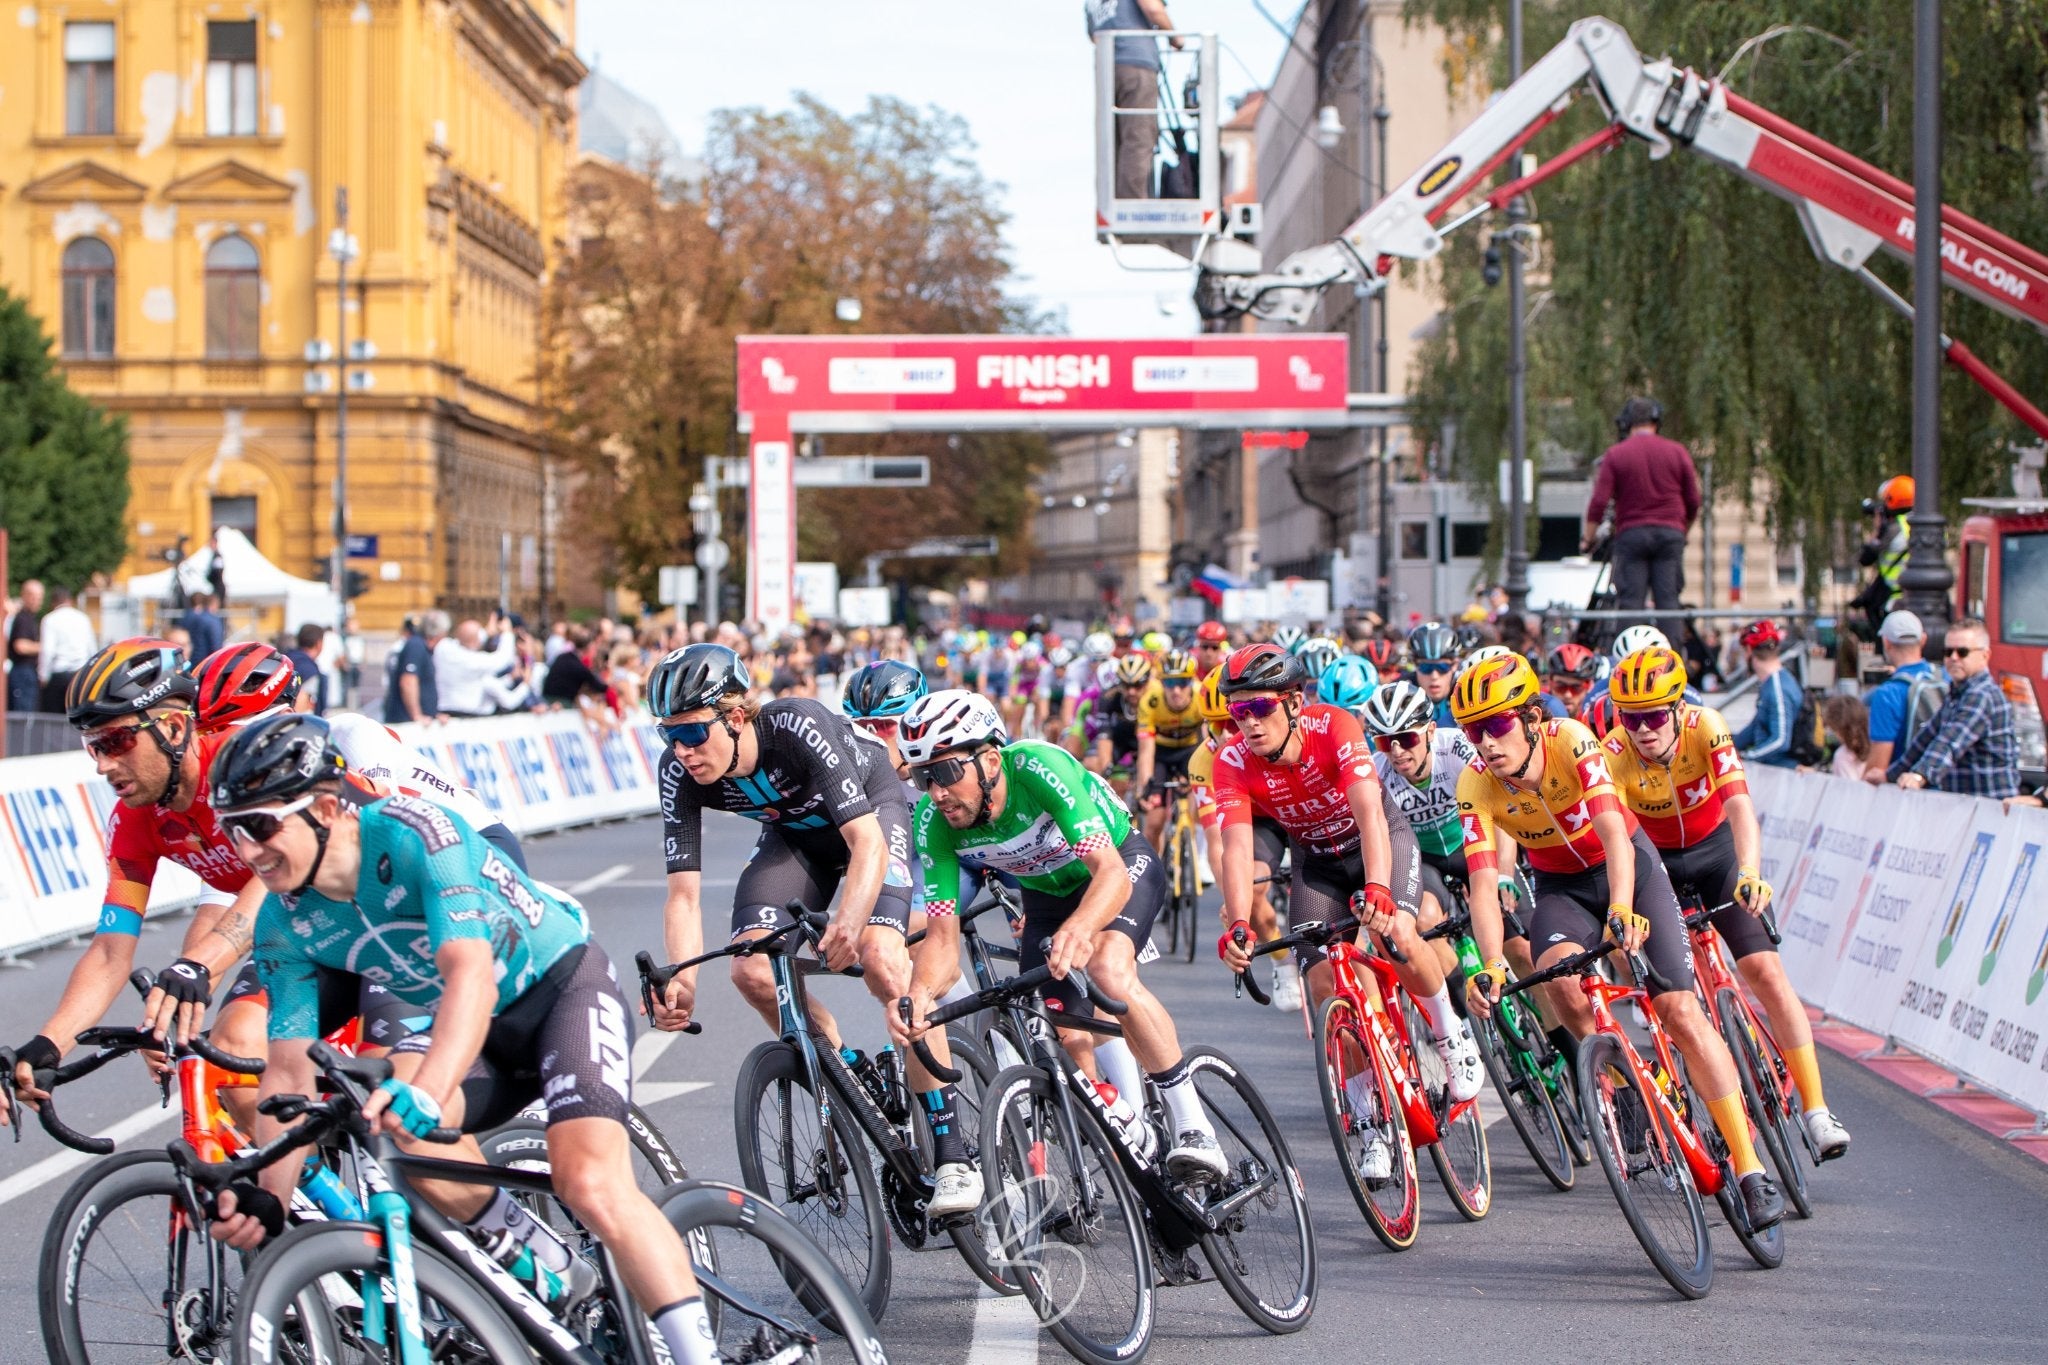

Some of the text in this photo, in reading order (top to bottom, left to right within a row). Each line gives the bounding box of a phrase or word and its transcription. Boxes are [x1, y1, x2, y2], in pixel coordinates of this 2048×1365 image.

[1896, 217, 2029, 300] RAL.COM
[977, 355, 1110, 388] FINISH
[132, 677, 172, 708] RUDY
[260, 663, 290, 696] TREK
[701, 675, 728, 700] SCOTT
[1265, 676, 1290, 688] RUDY
[769, 712, 840, 769] youfone
[411, 767, 455, 798] TREK
[661, 760, 685, 824] youfo
[1026, 757, 1076, 810] ŠKODA
[1275, 786, 1345, 819] HRE
[1401, 787, 1453, 812] CAJA
[1405, 802, 1457, 824] URA
[1456, 801, 1474, 811] no
[1638, 801, 1673, 812] Uno
[918, 799, 939, 848] ŠKOD
[1517, 827, 1556, 841] Uno
[171, 845, 239, 870] BAHR
[890, 825, 908, 860] DSM
[495, 1137, 548, 1154] metr
[64, 1203, 98, 1306] metron
